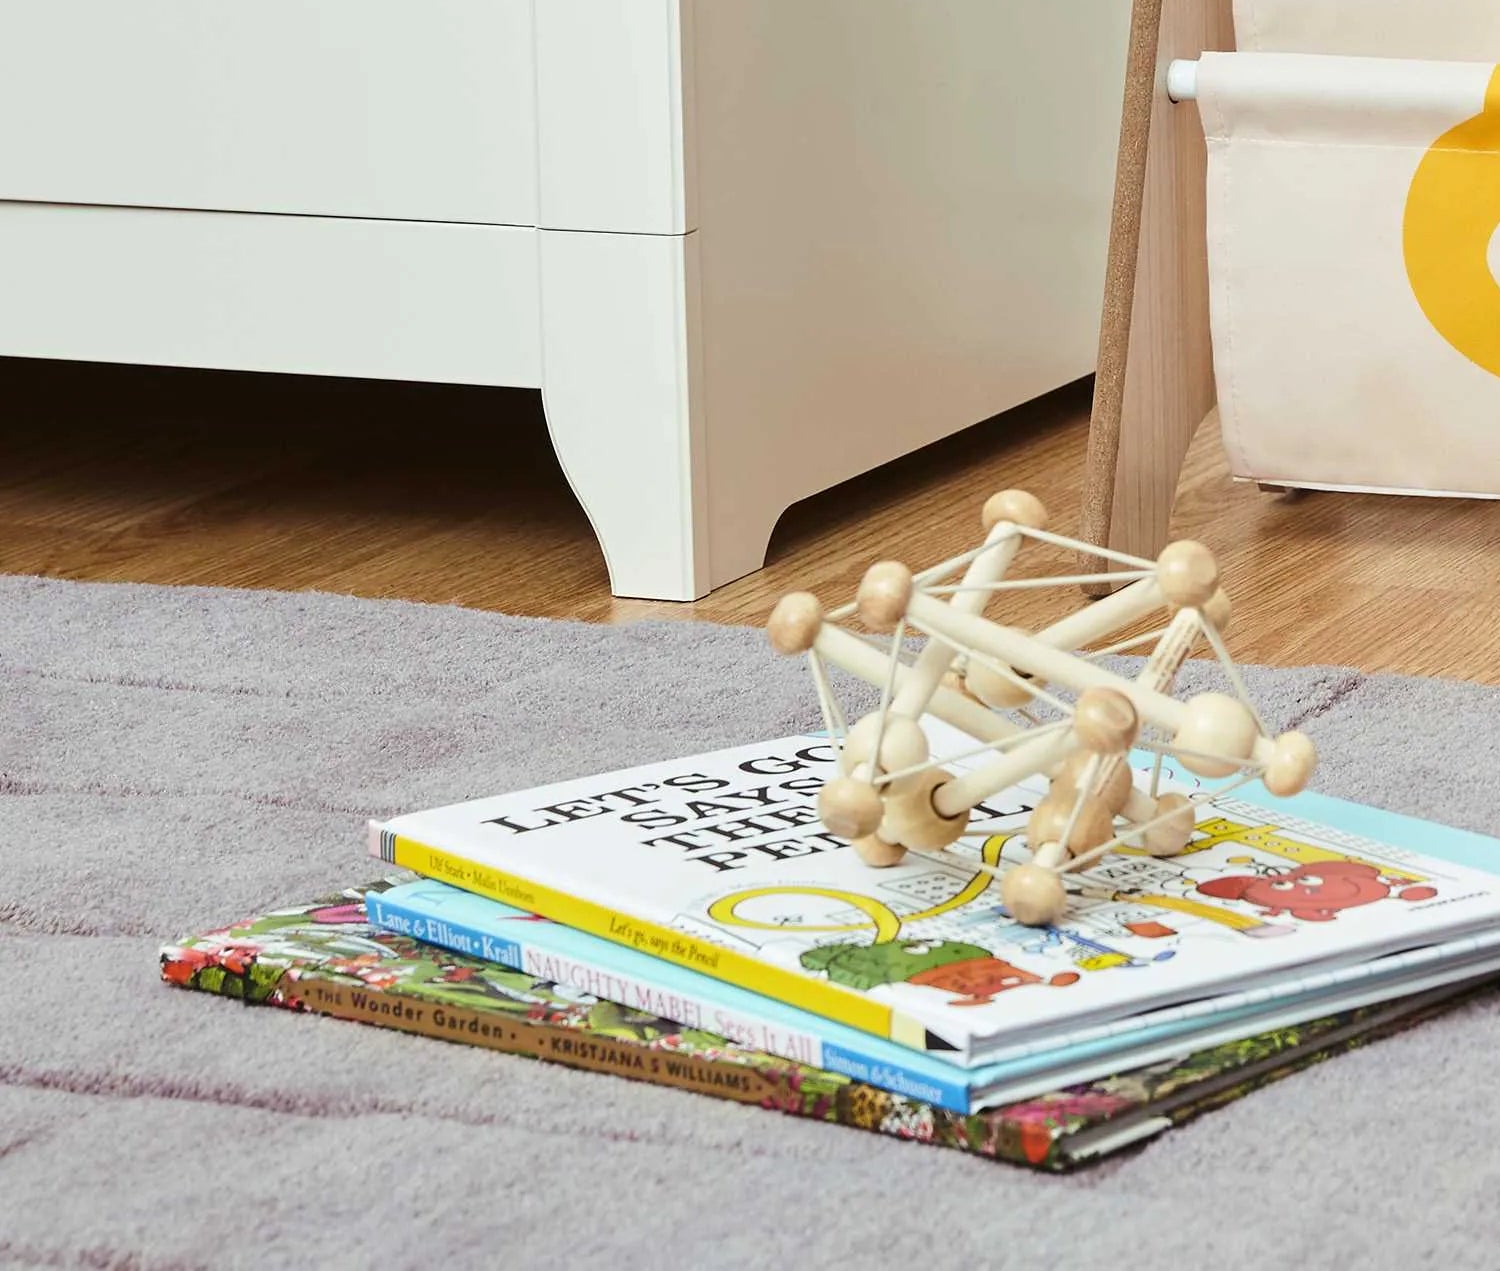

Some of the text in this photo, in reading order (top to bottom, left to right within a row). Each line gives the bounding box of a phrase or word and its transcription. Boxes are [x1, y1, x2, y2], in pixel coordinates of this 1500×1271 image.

[480, 773, 731, 835] LET'S
[620, 775, 826, 829] SAYS
[375, 902, 411, 931] Lane
[425, 917, 473, 953] Elliott
[480, 935, 521, 969] Krall
[687, 942, 721, 969] Pencil
[317, 988, 503, 1039] THE Wonder Garden
[526, 948, 630, 1003] NAUGHTY
[634, 983, 703, 1030] MABEL
[550, 1036, 751, 1092] KRISTJANA S WILLIAMS
